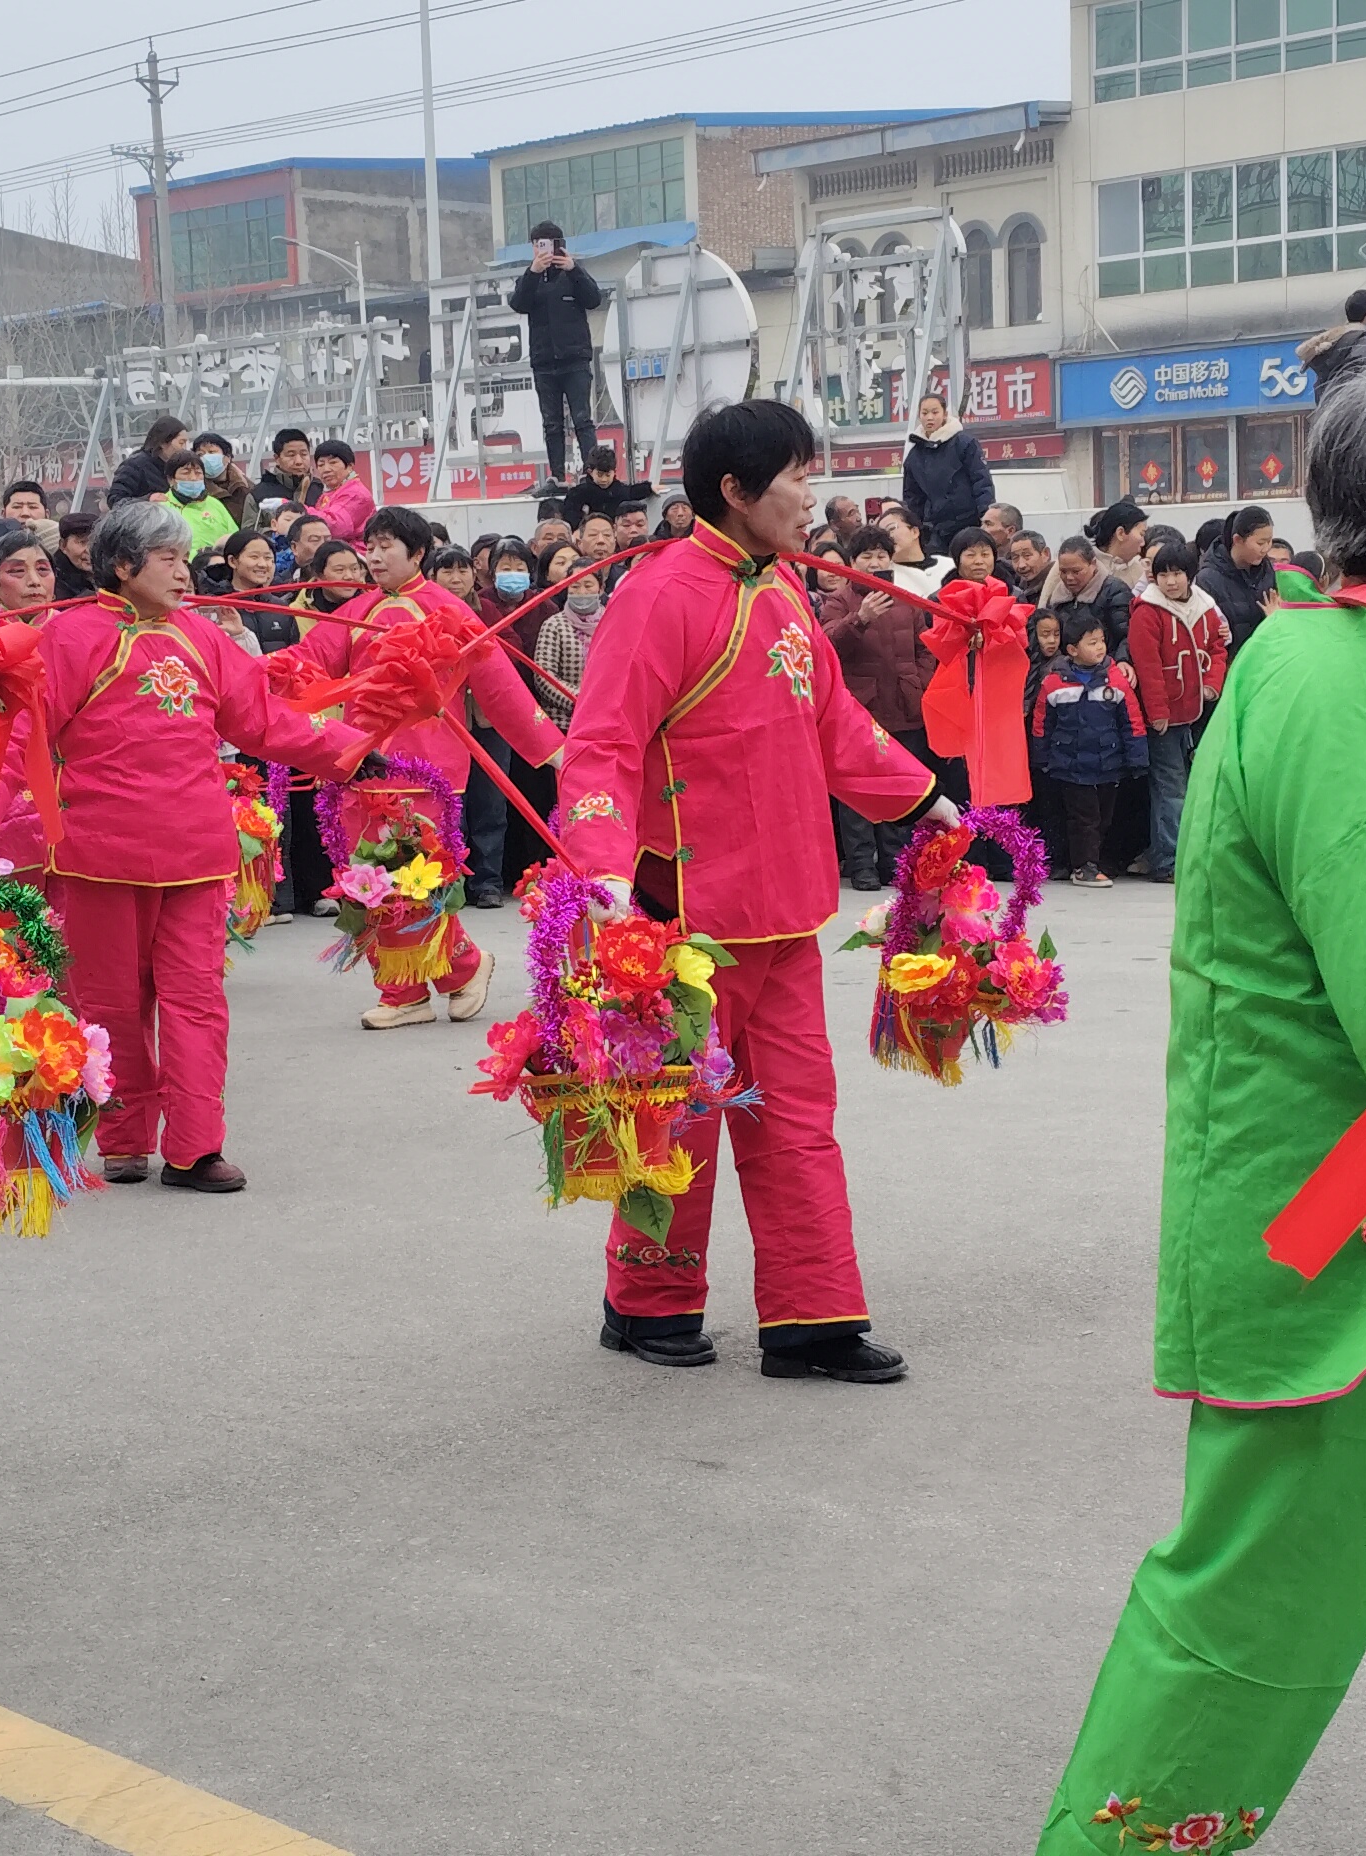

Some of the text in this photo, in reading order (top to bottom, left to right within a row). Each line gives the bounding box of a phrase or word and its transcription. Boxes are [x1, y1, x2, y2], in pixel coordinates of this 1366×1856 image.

[1154, 358, 1230, 387] 中国移动
[1259, 358, 1308, 397] 5G
[1155, 383, 1229, 402] China Mobile
